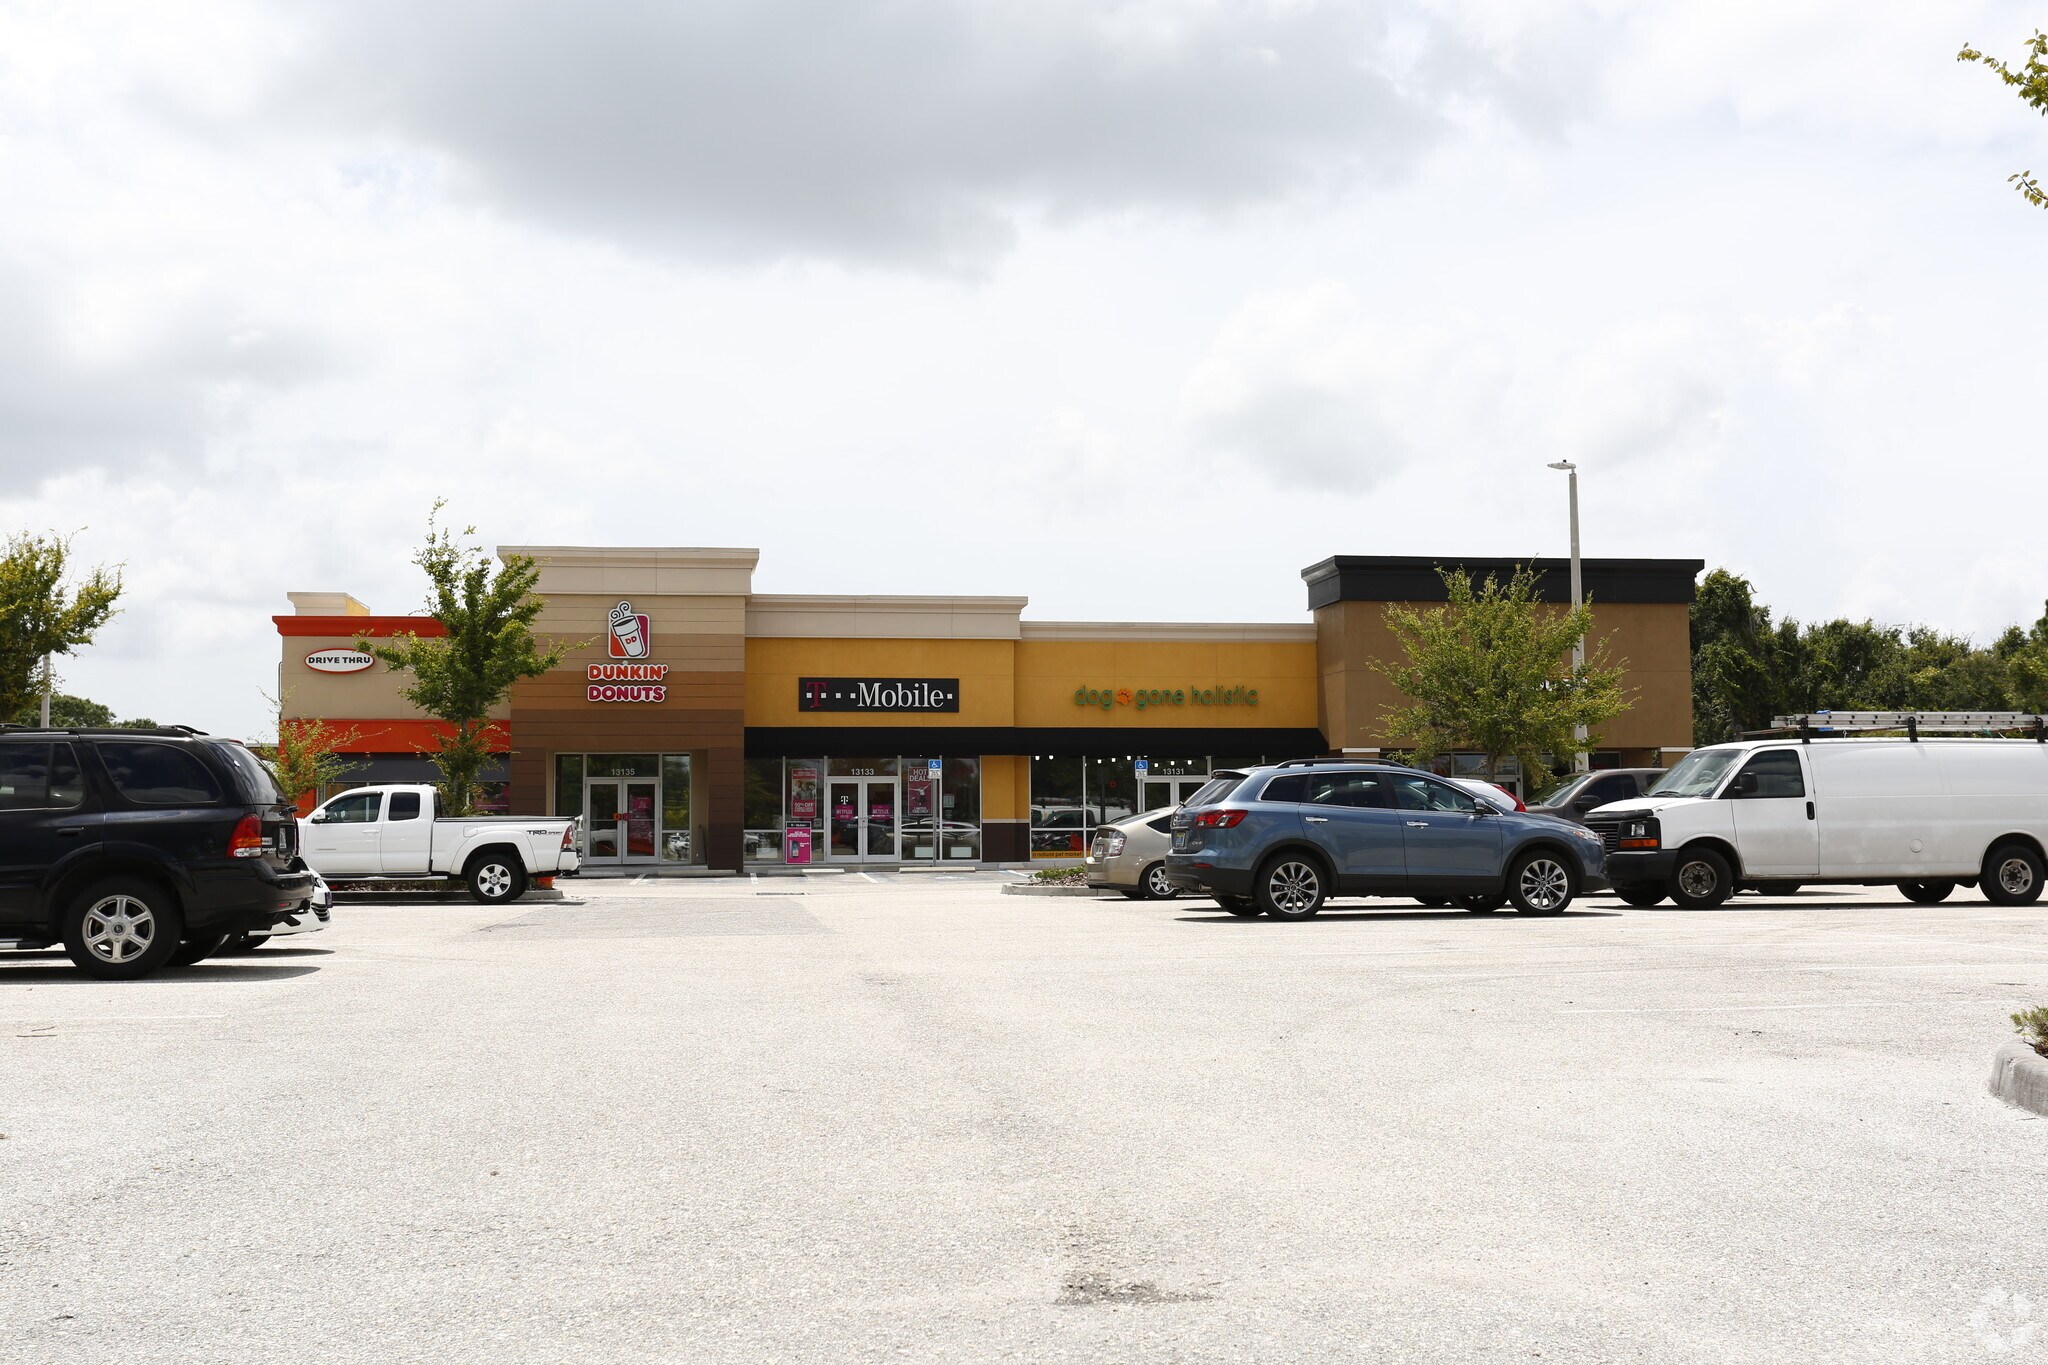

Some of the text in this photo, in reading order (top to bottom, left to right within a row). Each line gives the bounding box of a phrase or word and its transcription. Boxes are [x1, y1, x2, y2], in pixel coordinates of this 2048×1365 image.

[625, 636, 637, 645] DD
[308, 656, 370, 664] DRIVE THRU
[588, 664, 668, 680] DUNKIN'
[588, 685, 665, 702] DONUTS
[1074, 685, 1259, 710] dog gone holistic
[611, 768, 636, 776] 13135
[851, 768, 875, 776] 13133
